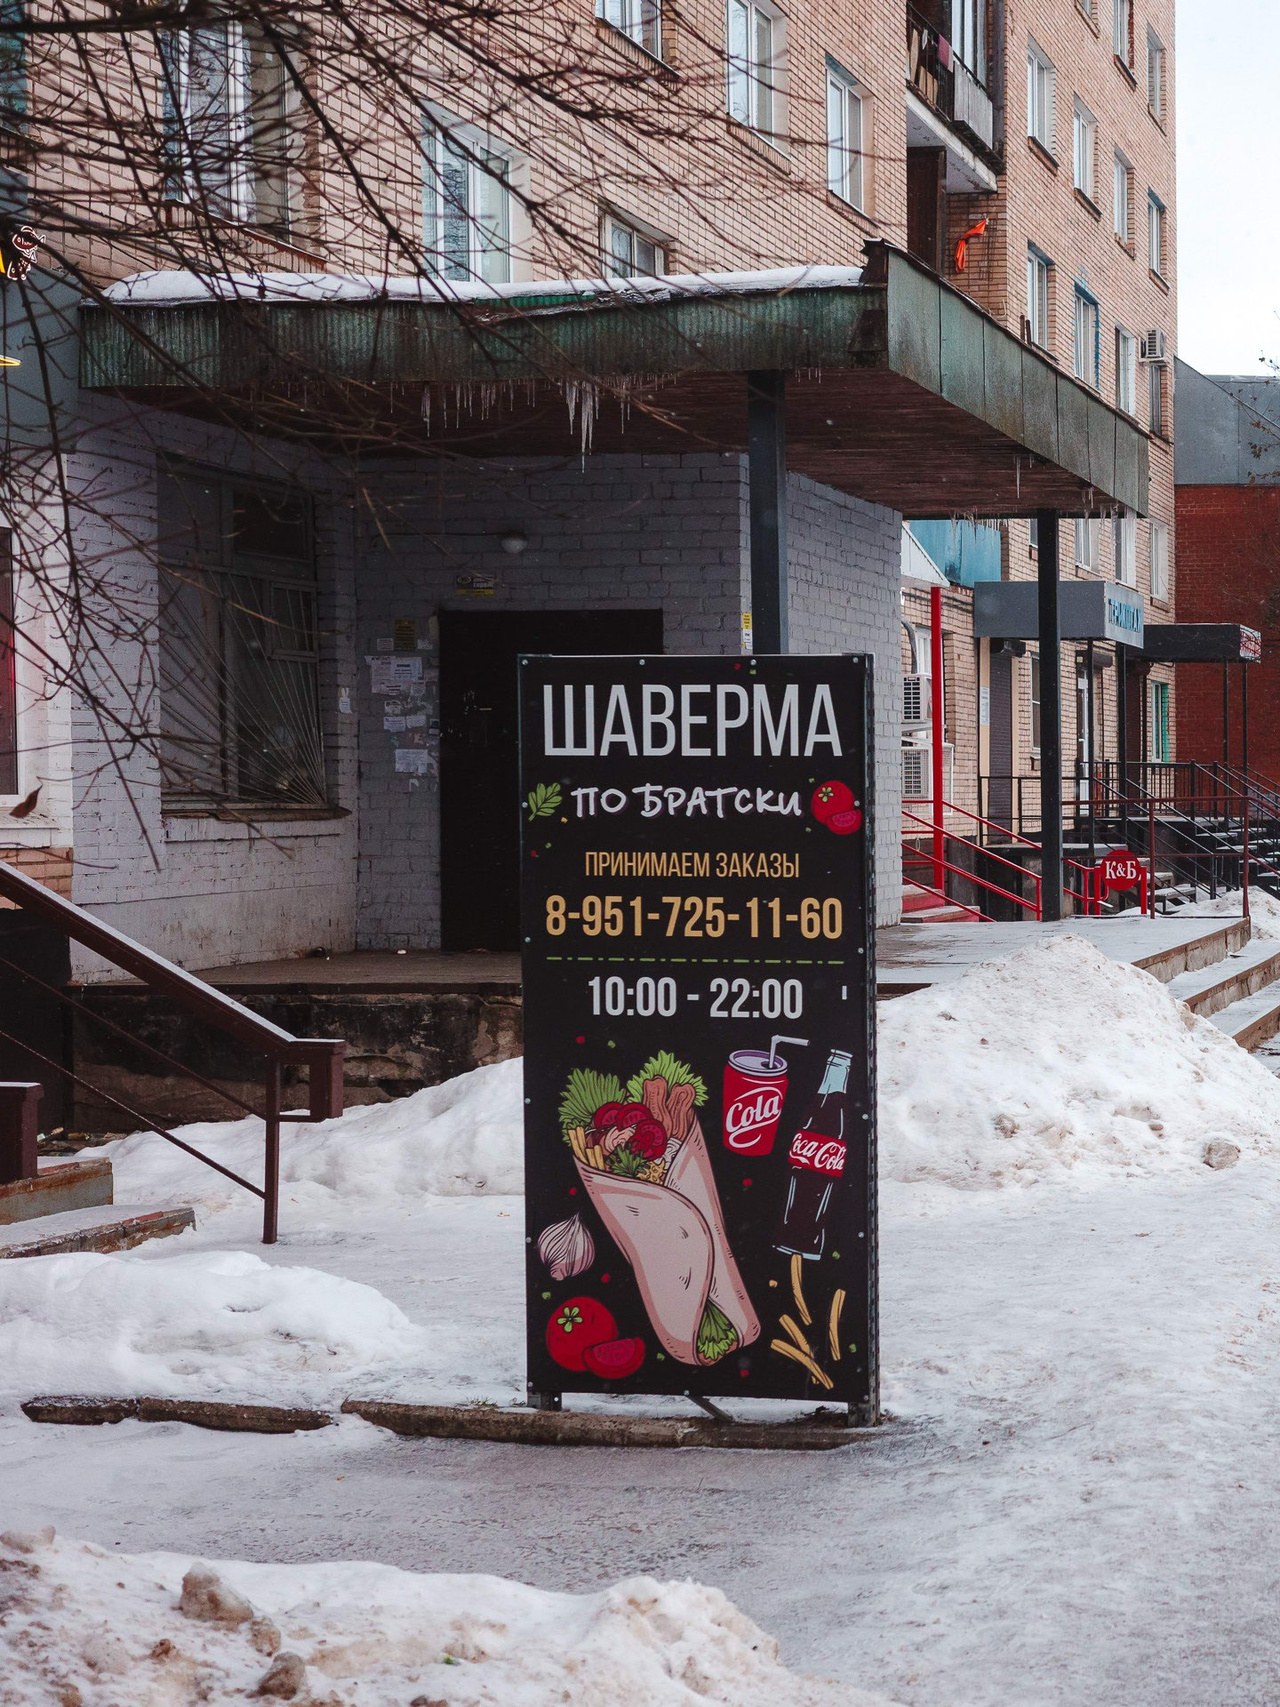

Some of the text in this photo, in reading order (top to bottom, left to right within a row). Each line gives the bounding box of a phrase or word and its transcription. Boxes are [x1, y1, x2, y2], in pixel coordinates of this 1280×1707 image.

[543, 684, 843, 757] ШАВЕРМА
[571, 783, 802, 819] ПО БРАТСКИ
[585, 851, 799, 878] ПРИНИМАЕМ ЗАКАЗЫ
[1105, 860, 1137, 879] К&Б
[545, 894, 843, 940] 8-951-725-11-60
[588, 976, 677, 1016] 10:00
[709, 978, 803, 1019] 22:00
[725, 1094, 782, 1133] Cola
